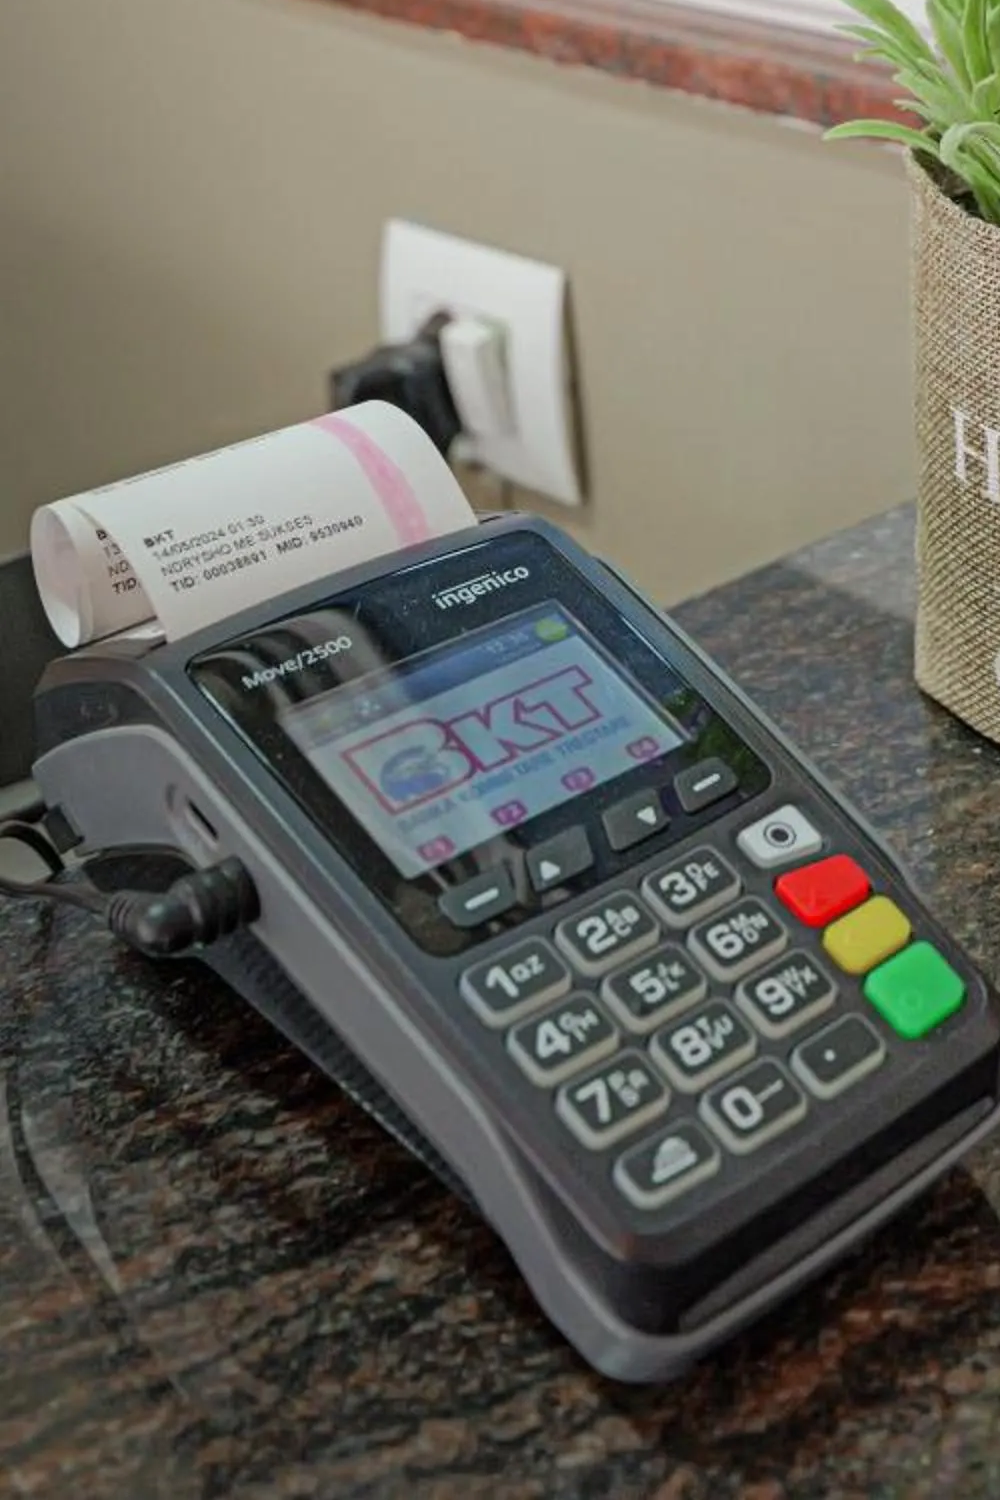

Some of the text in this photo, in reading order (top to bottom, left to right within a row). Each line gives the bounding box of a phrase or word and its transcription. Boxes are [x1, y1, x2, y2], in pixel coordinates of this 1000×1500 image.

[143, 529, 174, 549] BKT
[431, 566, 529, 609] ingenico
[241, 636, 352, 689] Move/2500
[341, 663, 602, 816] BKT
[659, 872, 697, 905] 3
[577, 915, 618, 954] 2
[706, 923, 745, 959] 6
[485, 965, 519, 998] 1
[629, 968, 667, 1004] 5
[755, 977, 794, 1015] 9
[536, 1020, 571, 1058] 4
[671, 1025, 712, 1067] 8
[575, 1078, 611, 1123] 7
